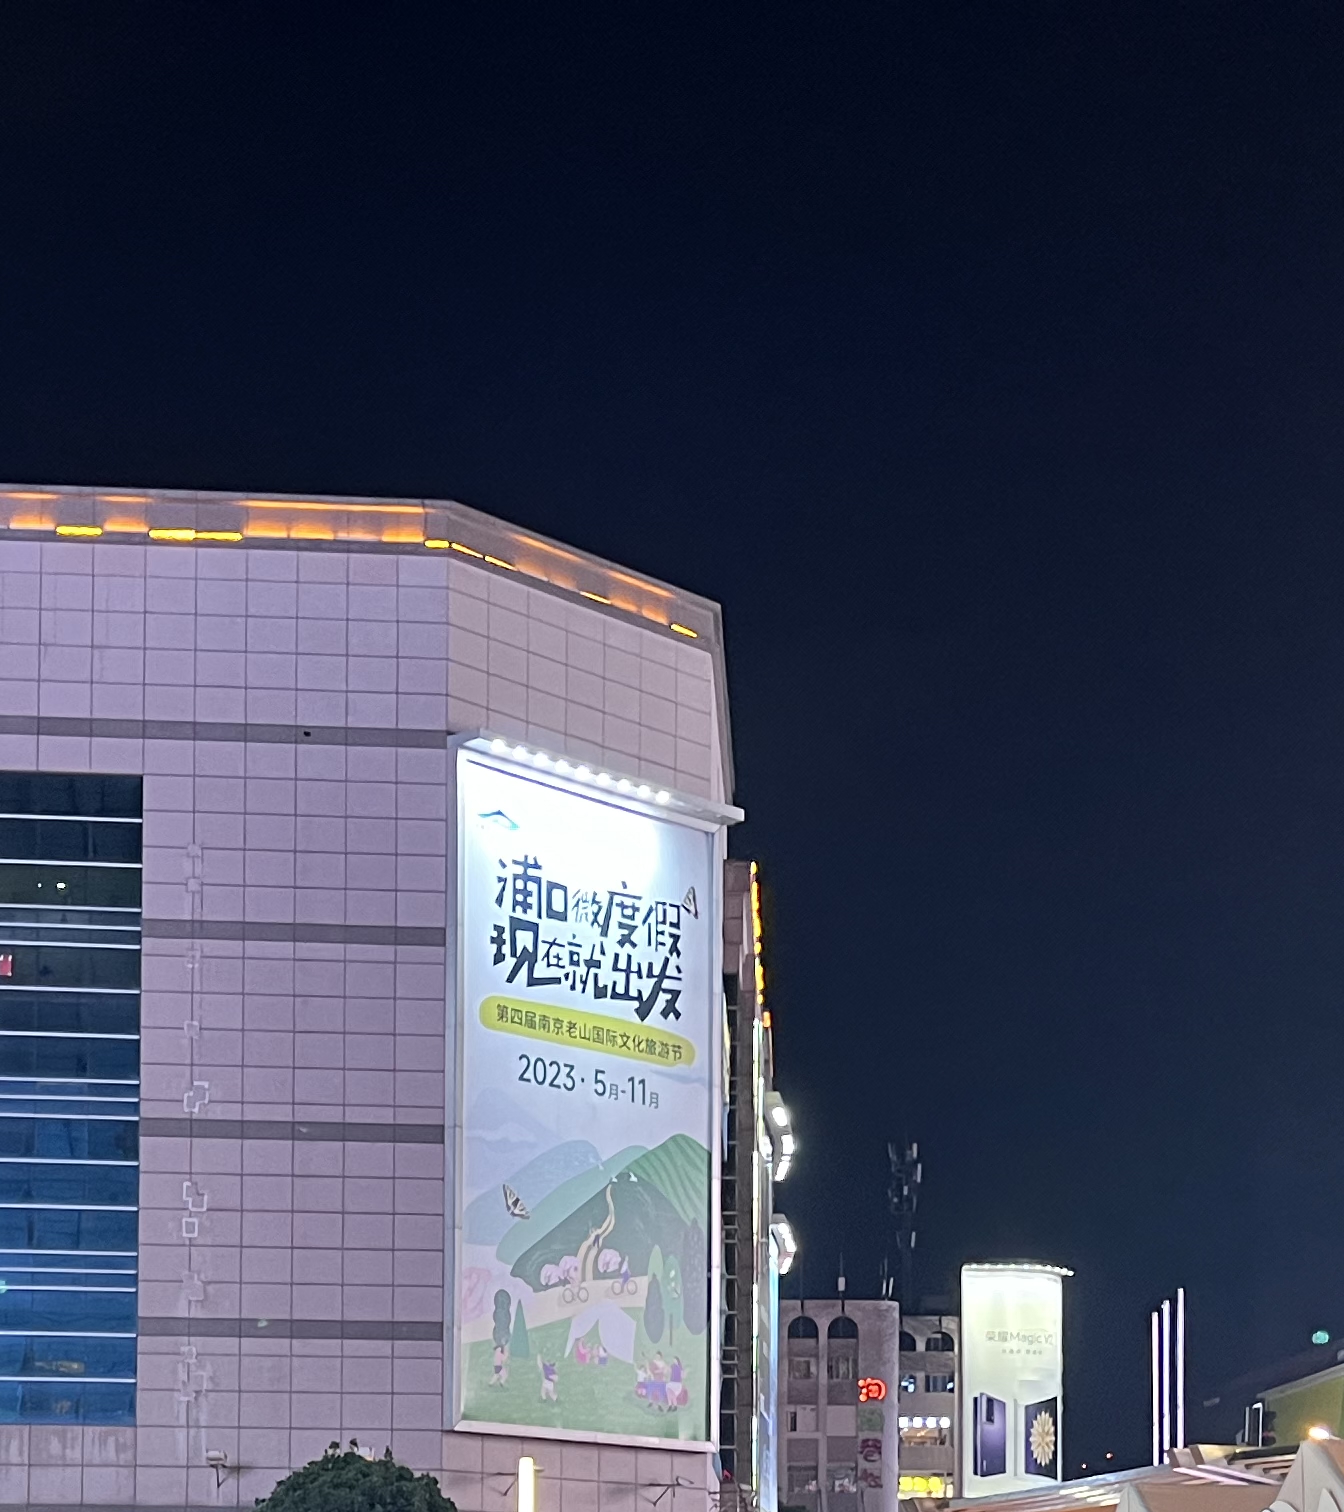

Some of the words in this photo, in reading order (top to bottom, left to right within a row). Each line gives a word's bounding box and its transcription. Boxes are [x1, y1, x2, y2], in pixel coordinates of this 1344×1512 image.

[494, 854, 682, 959] 浦口微度假
[490, 915, 683, 1023] 现在就出发
[496, 1003, 684, 1062] 第四届南京老山国际文化旅游节
